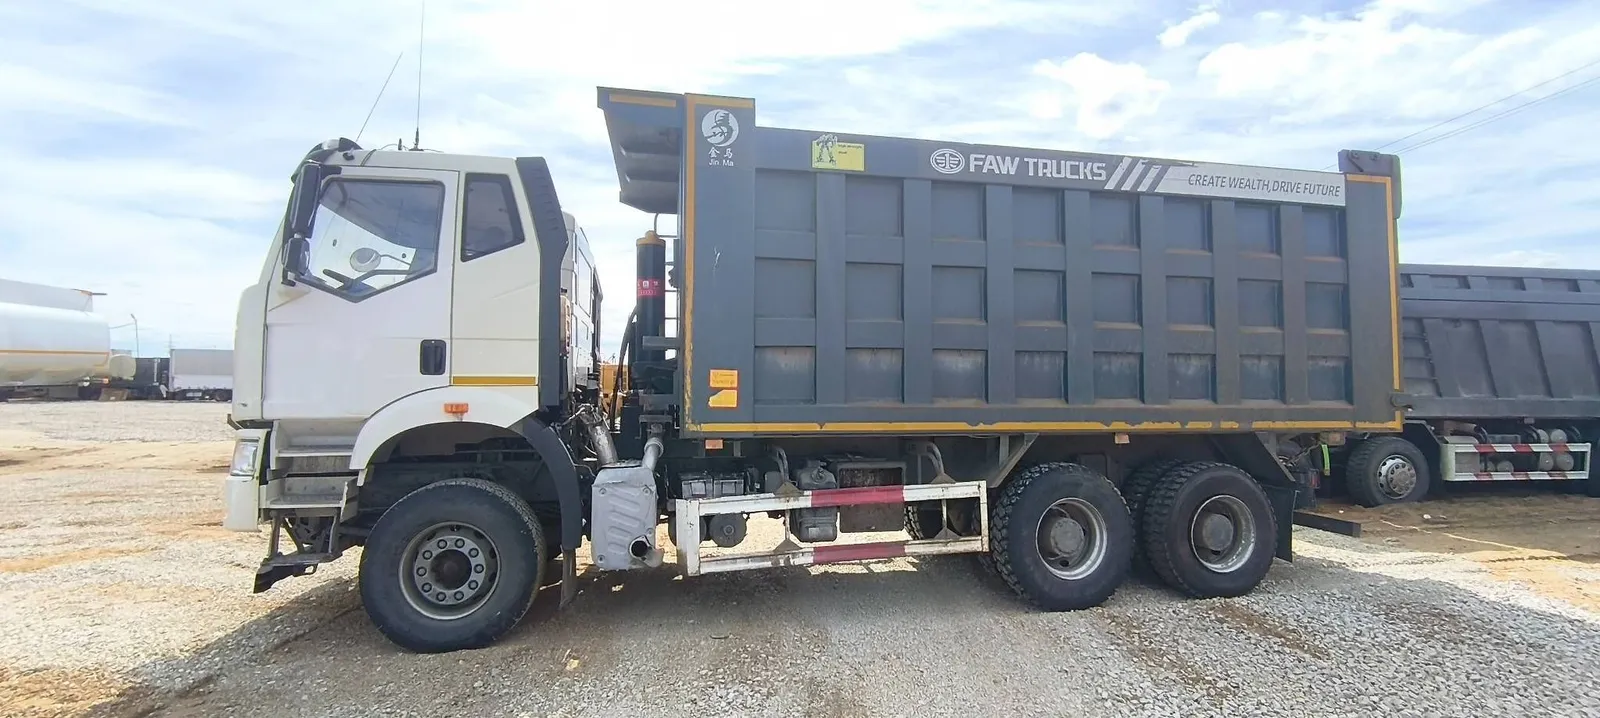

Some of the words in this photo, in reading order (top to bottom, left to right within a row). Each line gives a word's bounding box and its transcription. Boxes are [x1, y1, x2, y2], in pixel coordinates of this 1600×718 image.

[722, 159, 734, 167] Ma
[969, 153, 1020, 175] FAW
[1023, 157, 1107, 181] TRUCKS
[1188, 173, 1227, 188] CREATE
[1303, 183, 1341, 197] FUTURE
